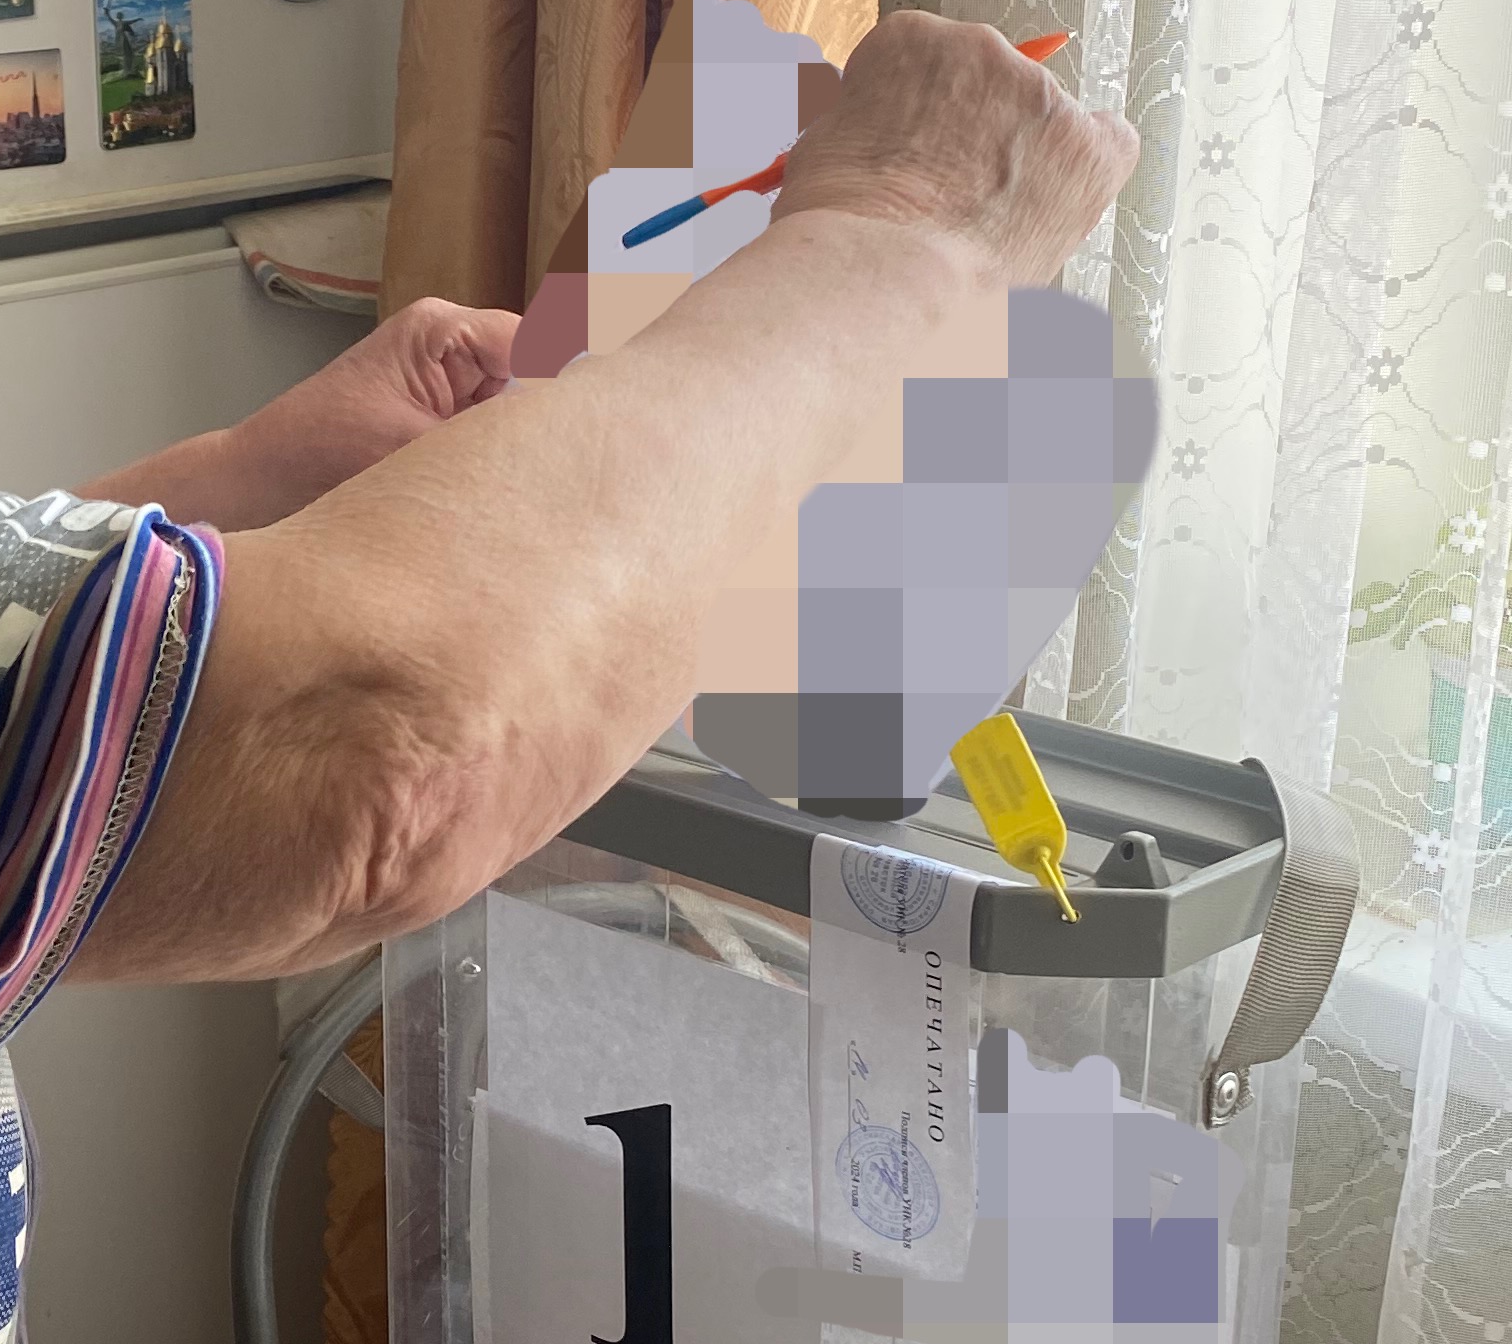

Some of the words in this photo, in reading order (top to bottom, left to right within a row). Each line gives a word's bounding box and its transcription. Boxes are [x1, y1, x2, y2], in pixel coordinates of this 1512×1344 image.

[924, 950, 945, 1144] ОПЕЧАТАНО
[900, 1110, 912, 1157] Подписи
[850, 1159, 861, 1183] 2024
[901, 1159, 911, 1195] членов
[901, 1197, 912, 1223] УИК
